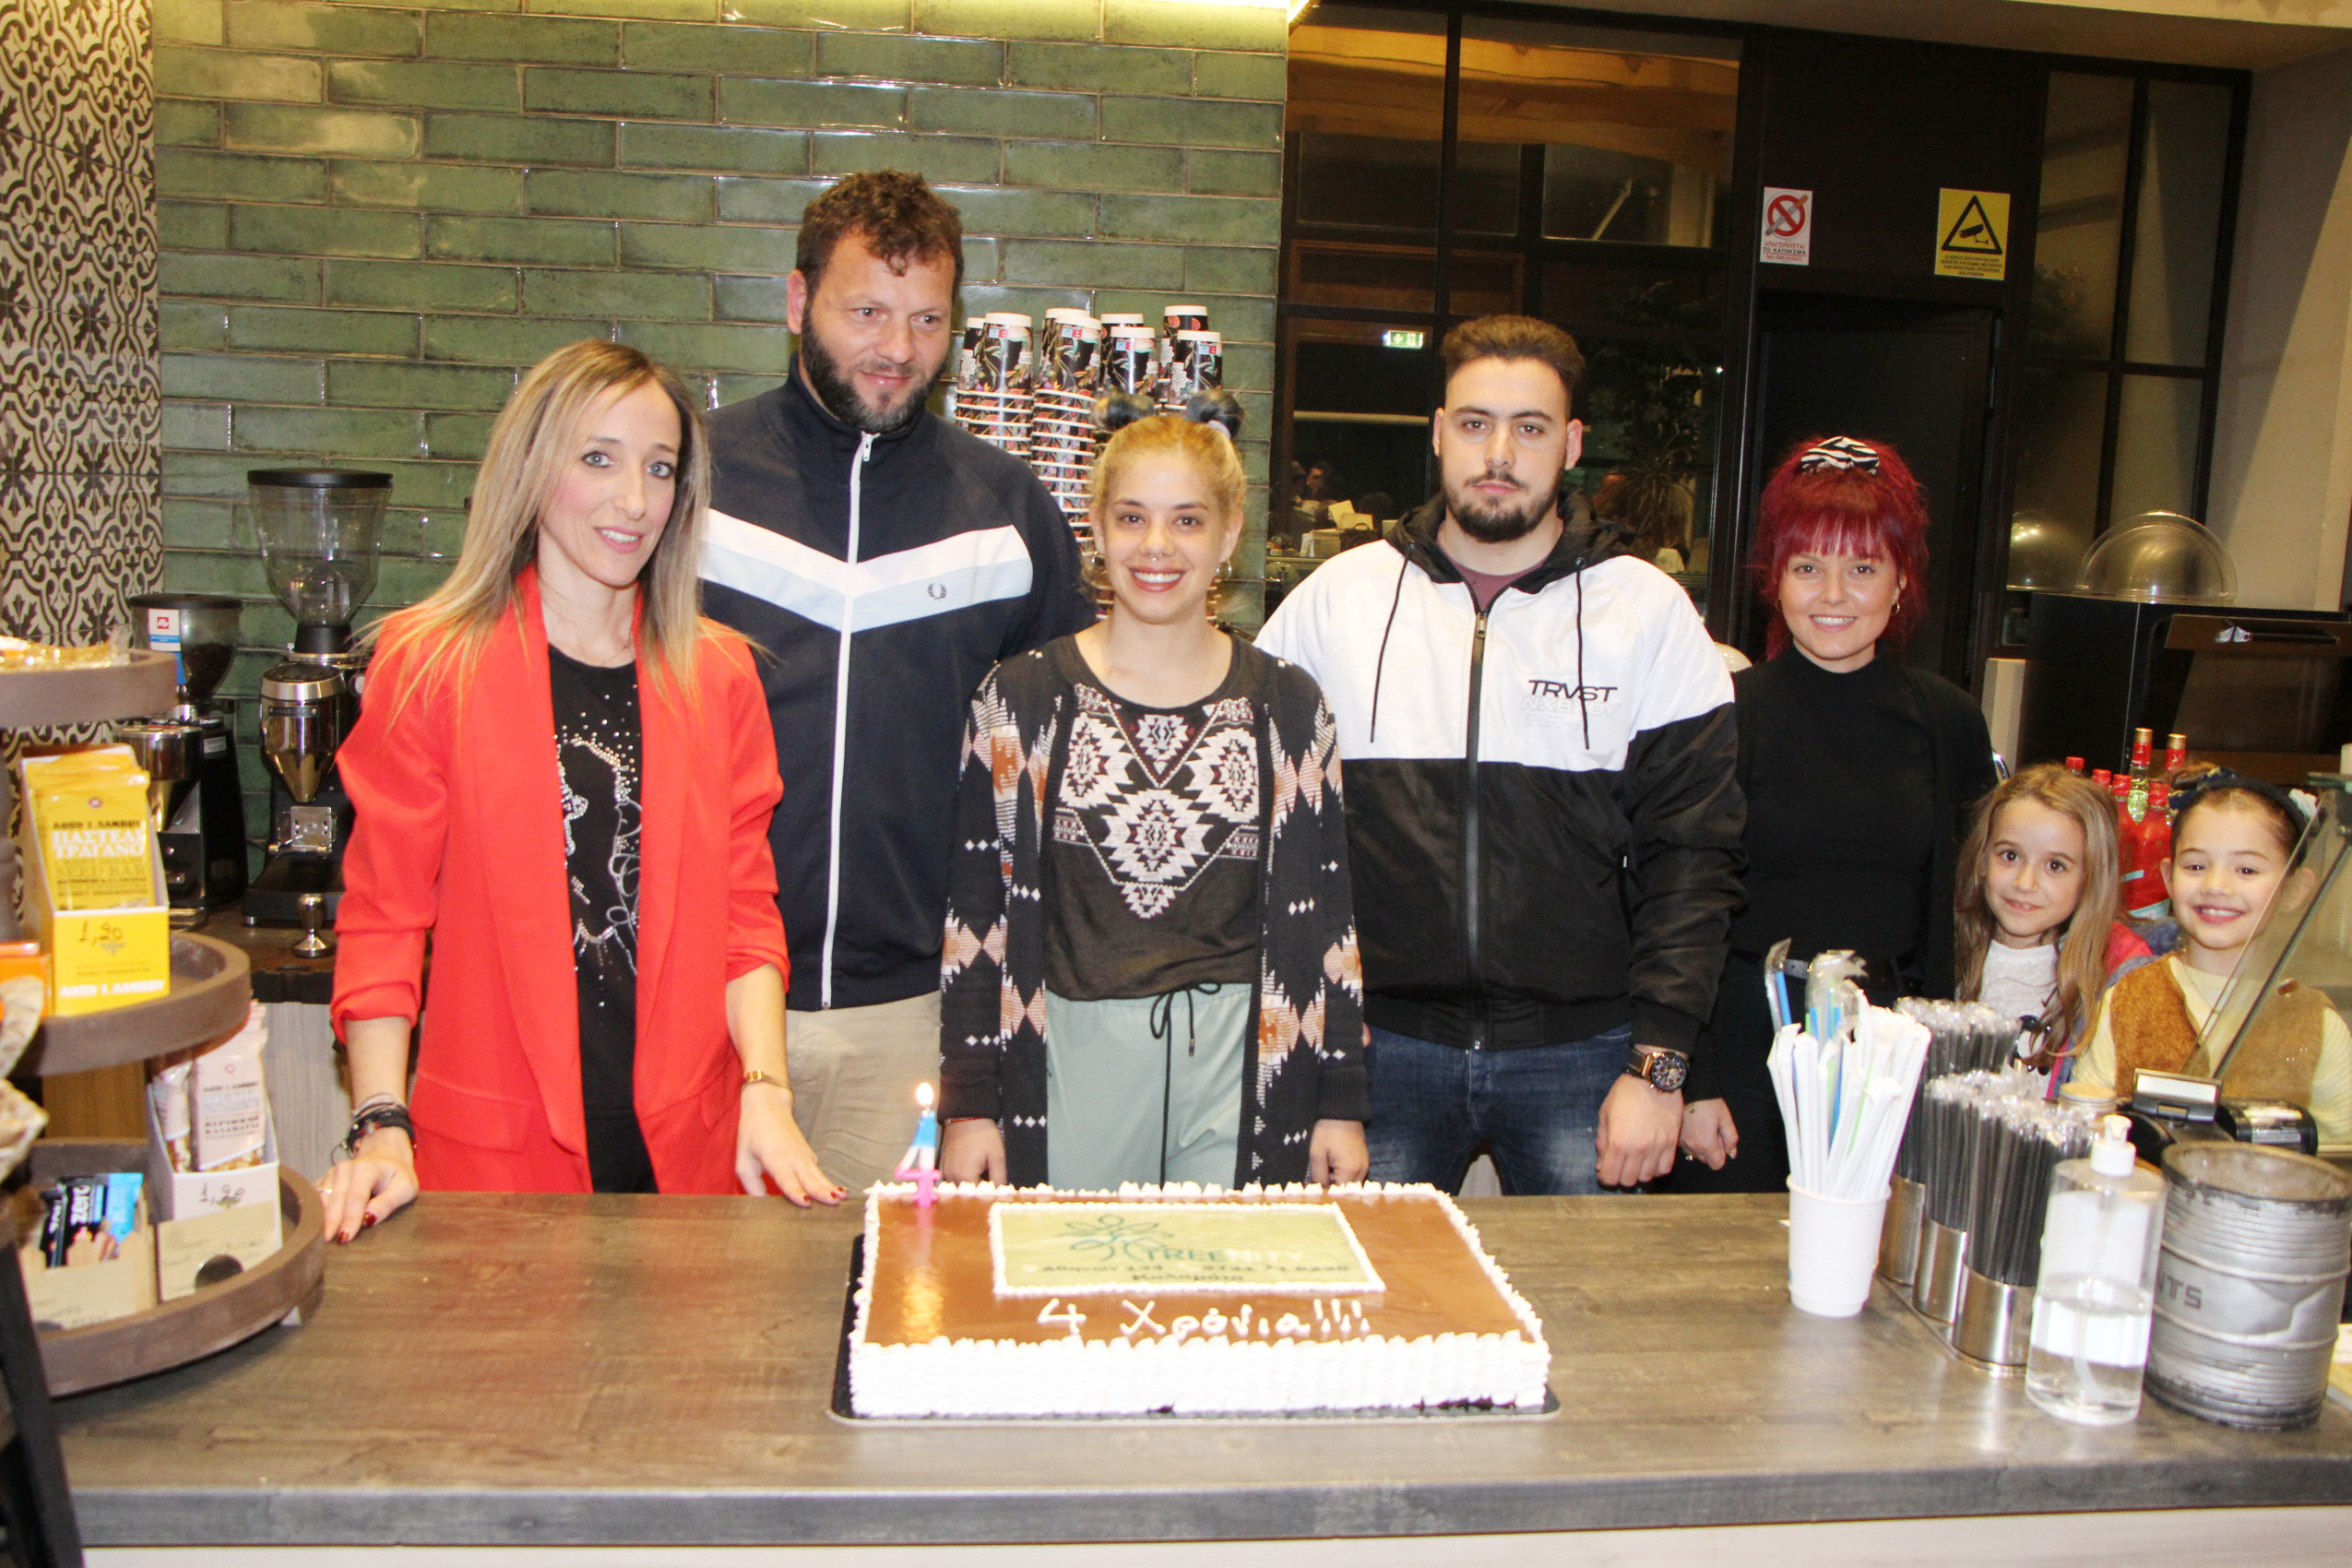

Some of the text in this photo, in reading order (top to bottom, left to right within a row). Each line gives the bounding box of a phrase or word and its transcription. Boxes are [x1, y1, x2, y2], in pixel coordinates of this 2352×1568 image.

[1528, 680, 1619, 703] TRVST
[53, 843, 146, 859] ΤΡΑΓΑΝΟ
[1144, 1247, 1305, 1263] TREENITY
[1037, 1297, 1087, 1336] 4
